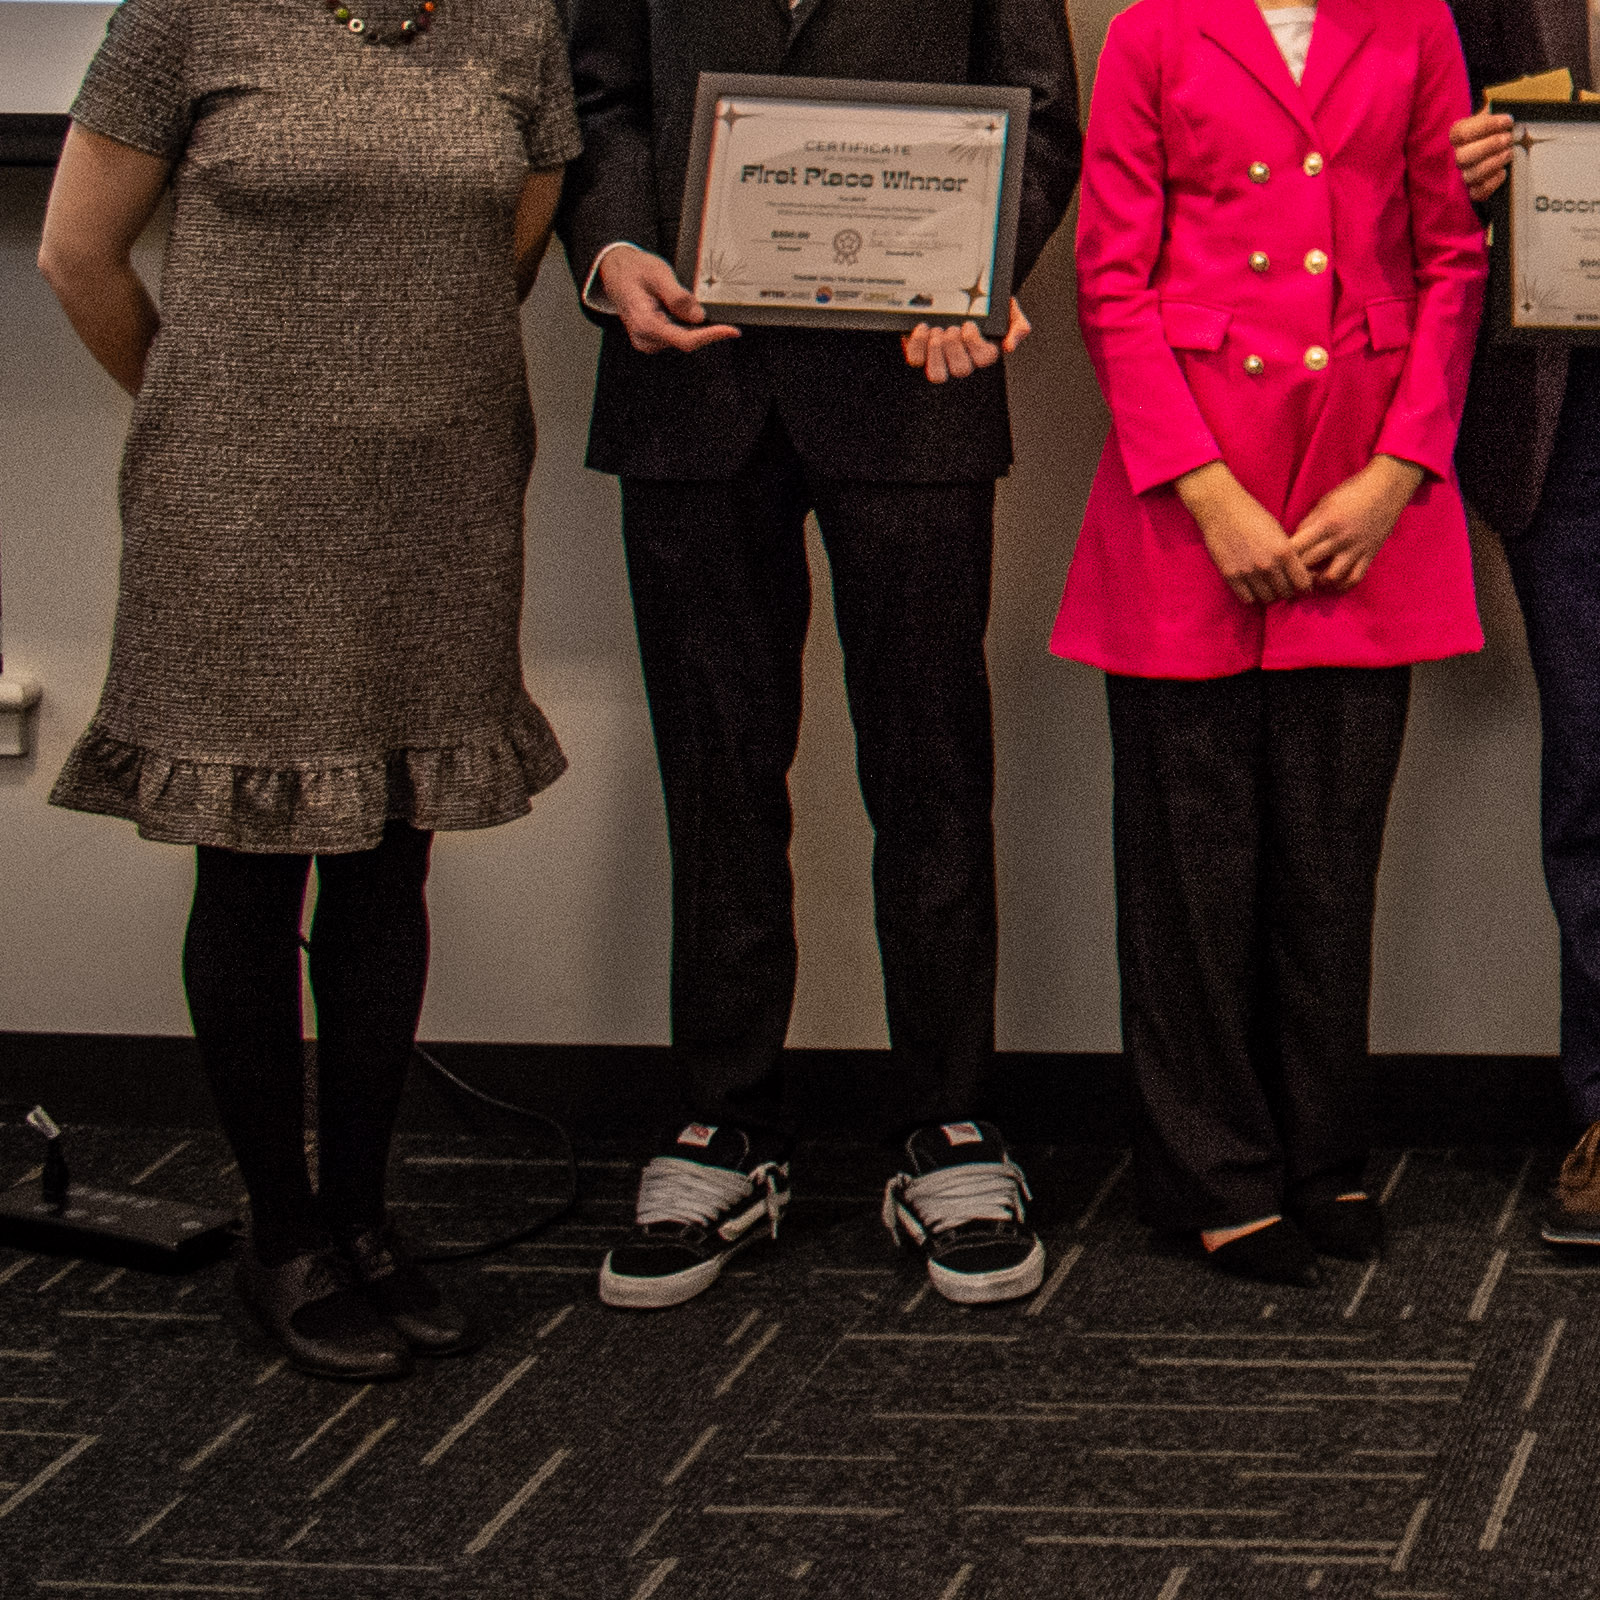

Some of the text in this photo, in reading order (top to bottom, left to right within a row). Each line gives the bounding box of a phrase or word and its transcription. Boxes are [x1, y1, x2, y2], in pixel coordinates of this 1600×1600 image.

[803, 140, 912, 156] CERTIFICATE
[740, 164, 968, 193] First Place Winner
